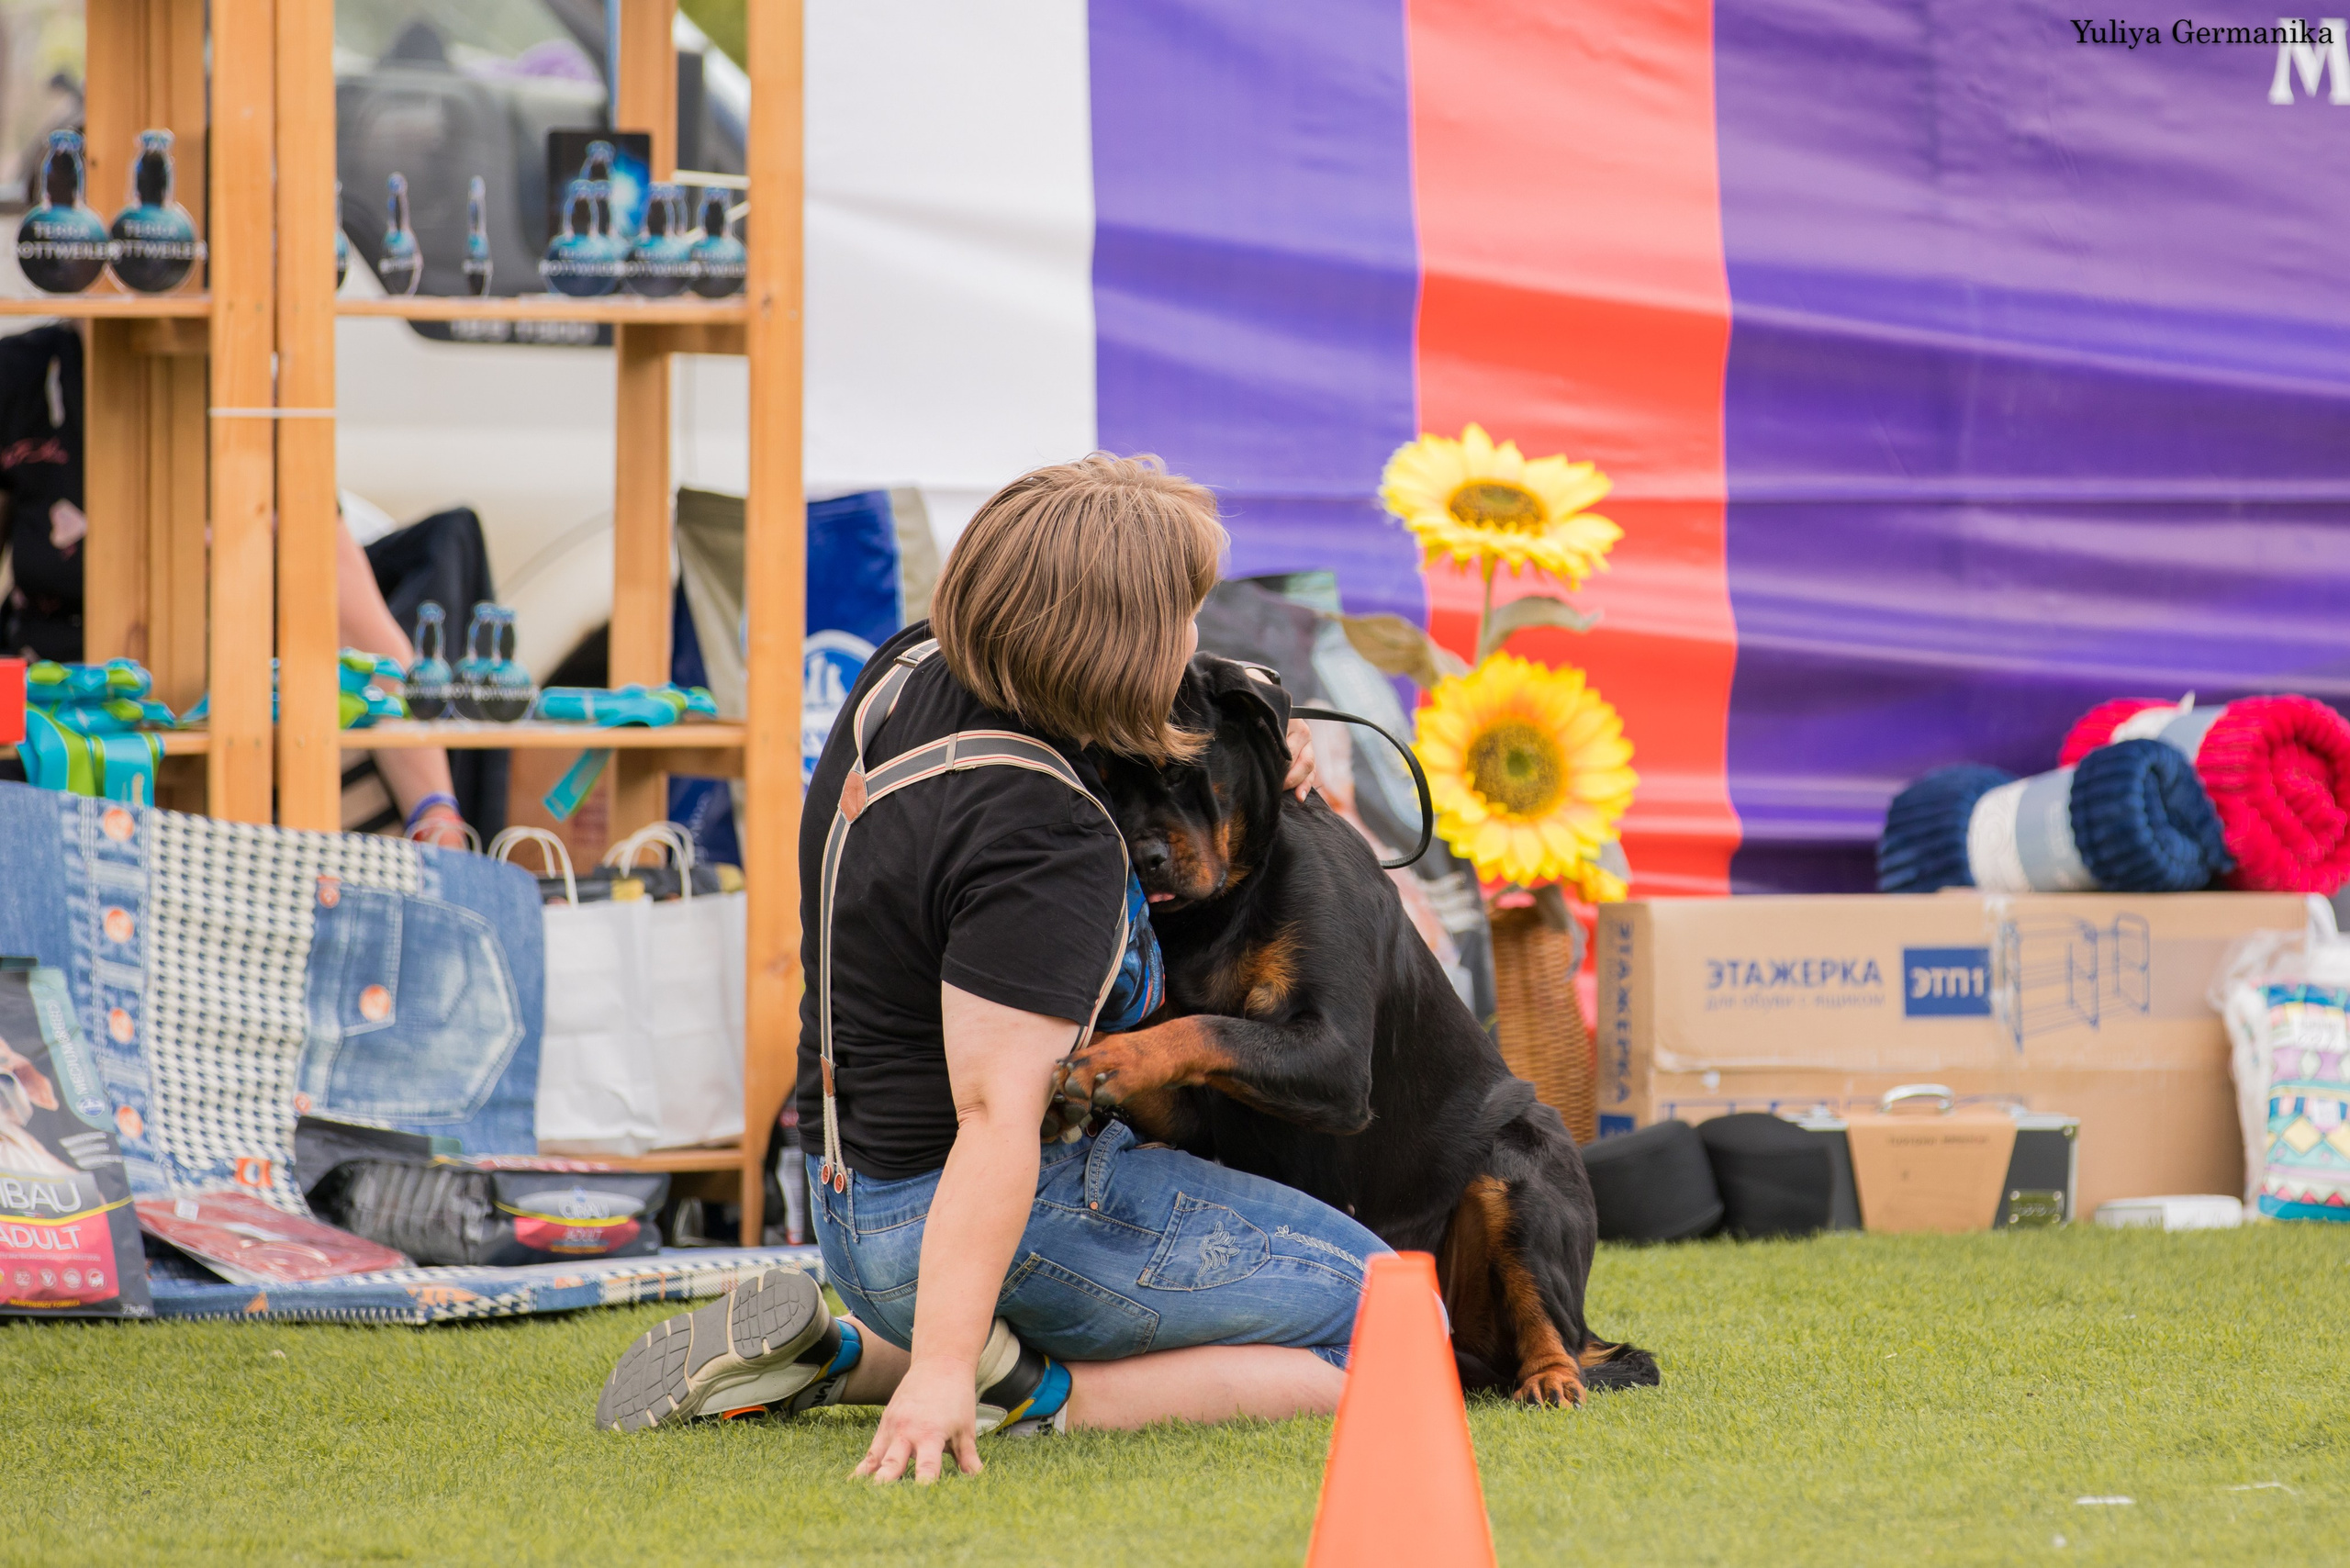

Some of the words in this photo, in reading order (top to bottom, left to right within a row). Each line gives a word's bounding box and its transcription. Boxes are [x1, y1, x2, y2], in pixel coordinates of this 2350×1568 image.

[1705, 958, 1885, 990] ЭТАЖЕРКА
[1910, 967, 1985, 999] ЭТП1
[1617, 921, 1635, 1103] ЭТАЖЕРКА
[1705, 992, 1737, 1011] для
[1743, 991, 1796, 1014] обуви
[1814, 992, 1886, 1008] ящиком
